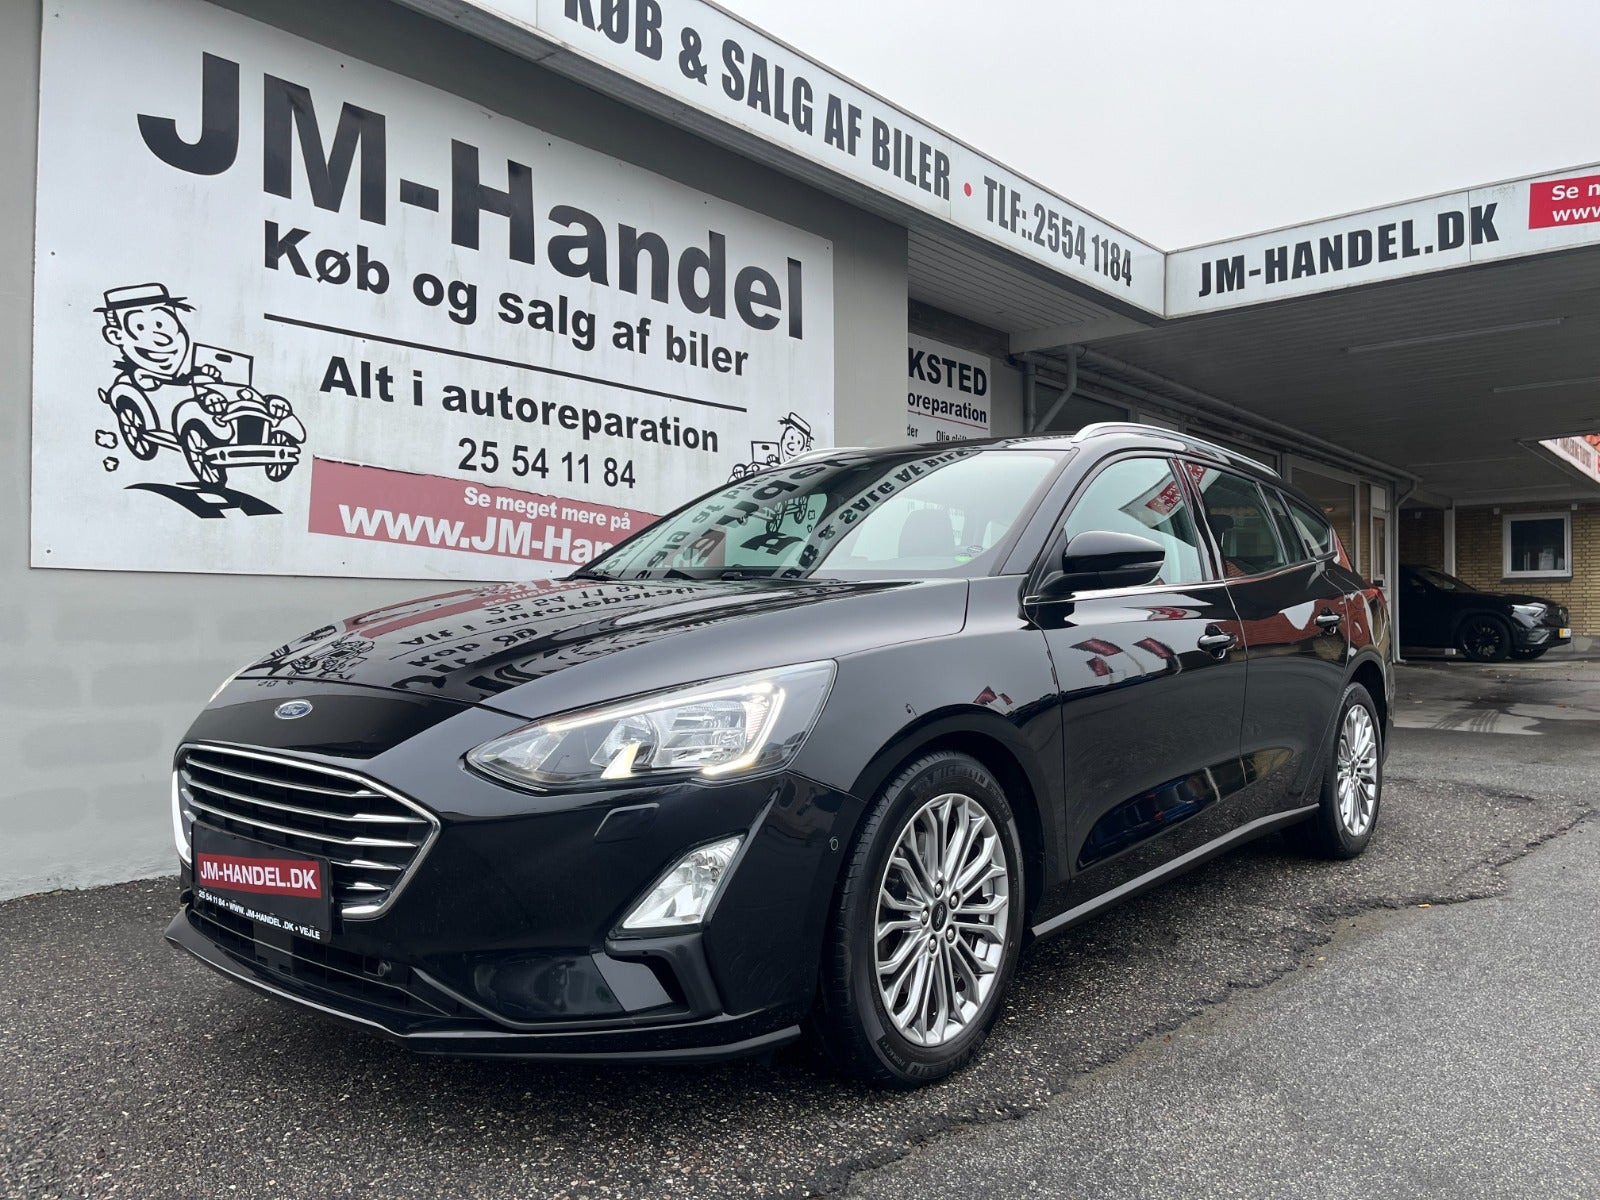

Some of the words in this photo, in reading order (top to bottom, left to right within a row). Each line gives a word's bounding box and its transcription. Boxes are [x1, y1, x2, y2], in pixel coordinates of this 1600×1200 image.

[679, 27, 707, 85] &
[722, 40, 813, 136] SALG
[825, 94, 861, 156] AF
[873, 117, 950, 200] BILER
[138, 52, 803, 340] JM-Handel
[1552, 185, 1579, 201] Se
[1092, 235, 1132, 287] 1184
[1198, 203, 1500, 298] JM-HANDEL.DK
[265, 221, 390, 295] Køb
[413, 274, 477, 325] og
[499, 292, 596, 352] salg
[613, 319, 652, 356] af
[667, 325, 749, 376] biler
[908, 347, 987, 397] KSTED
[320, 355, 394, 403] Alt
[414, 371, 423, 407] i
[443, 385, 719, 453] autoreparation
[908, 392, 987, 423] oreparation
[458, 437, 499, 474] 25
[512, 445, 549, 479] 54
[561, 451, 589, 484] 11
[604, 457, 636, 489] 84
[464, 486, 491, 508] Se
[495, 495, 558, 520] meget
[561, 506, 607, 526] mere
[610, 511, 631, 532] på
[200, 860, 317, 890] JM-HANDEL.DK
[198, 889, 206, 899] 25
[205, 892, 213, 903] 54
[213, 895, 218, 904] 11
[218, 897, 226, 907] 84
[246, 909, 282, 928] JM-HANDEL
[299, 925, 321, 940] VEJLE
